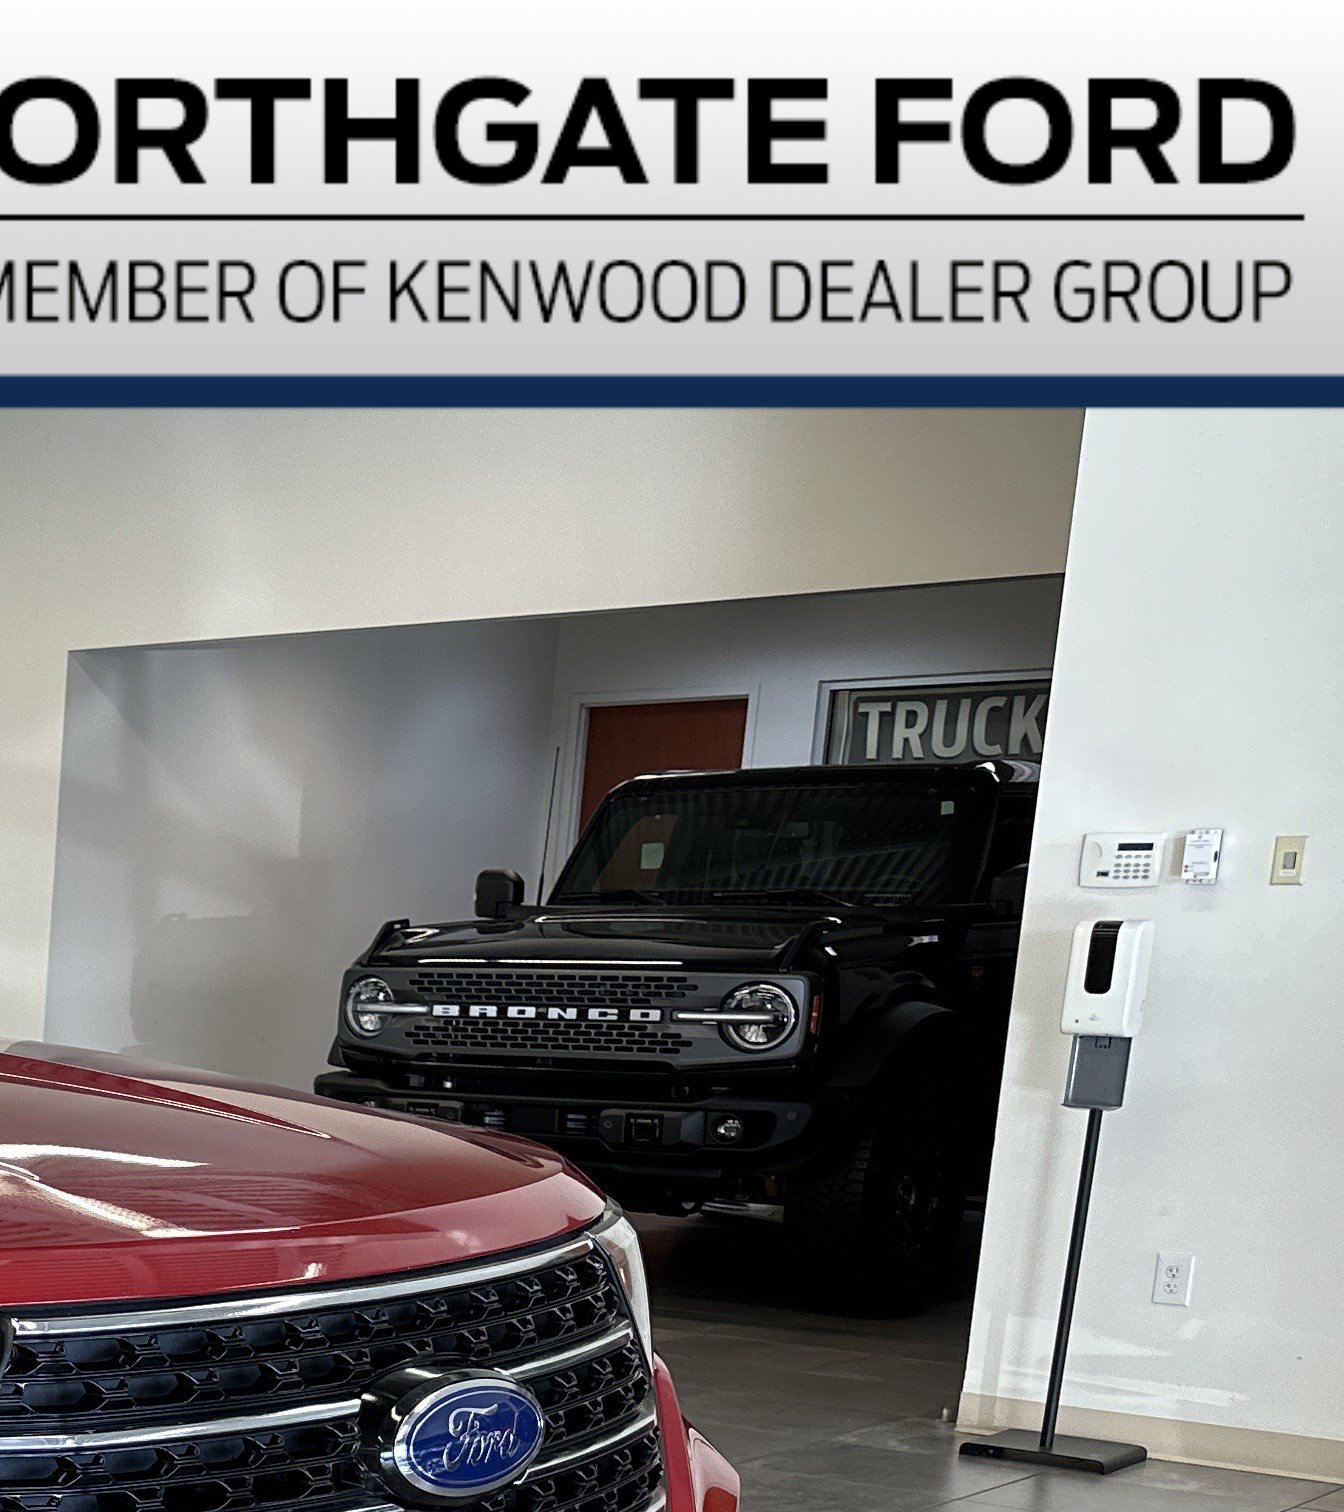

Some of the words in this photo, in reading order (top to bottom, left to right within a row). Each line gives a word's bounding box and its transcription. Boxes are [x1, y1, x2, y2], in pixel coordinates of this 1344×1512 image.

[857, 694, 1049, 760] TRUCK
[432, 1004, 662, 1022] BRONCO
[441, 1402, 521, 1473] Ford
